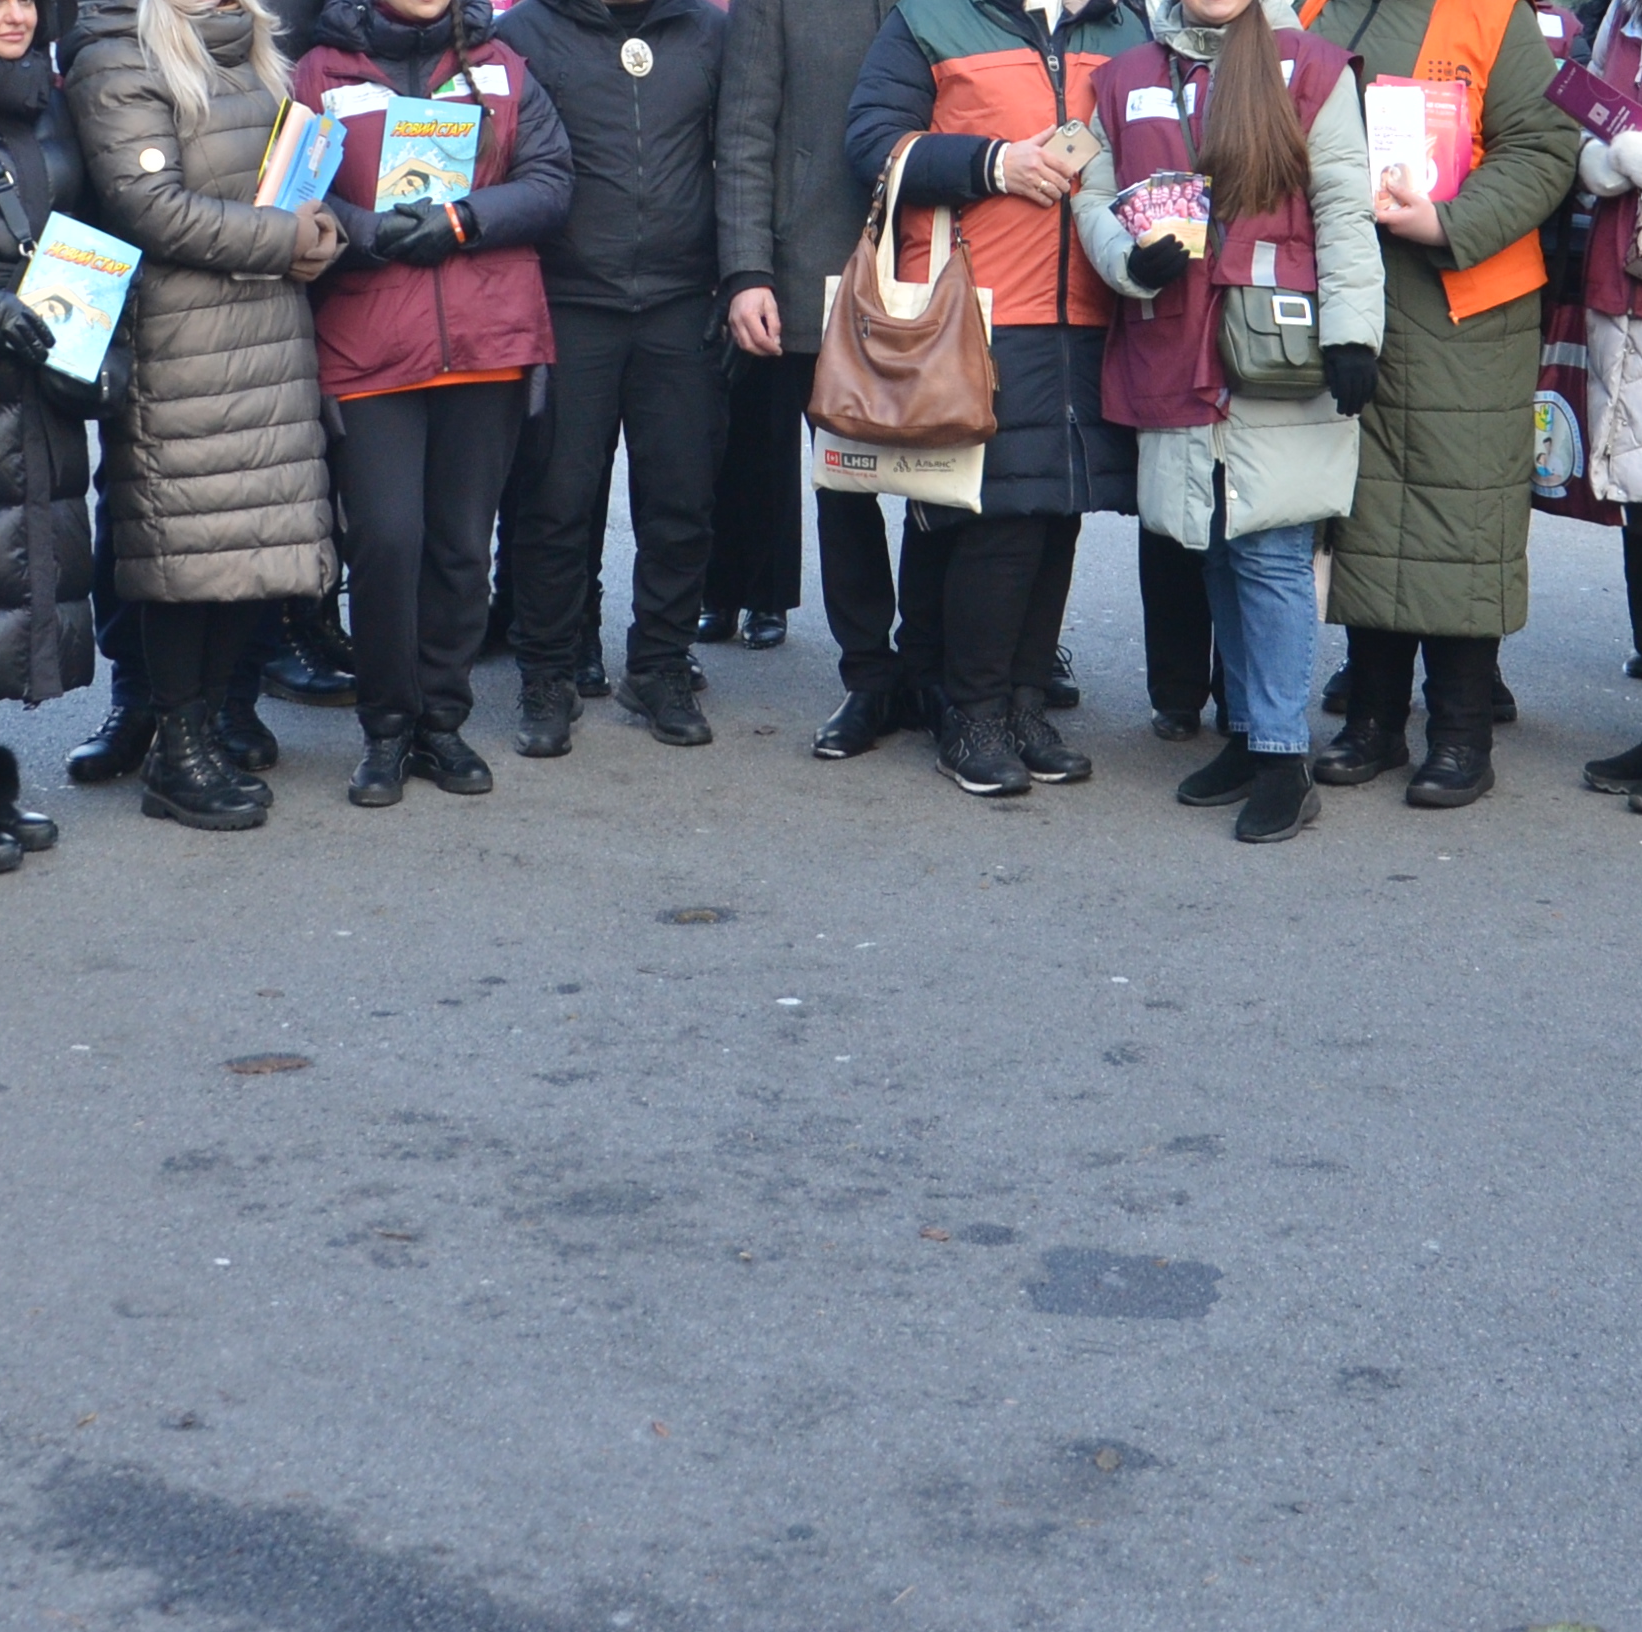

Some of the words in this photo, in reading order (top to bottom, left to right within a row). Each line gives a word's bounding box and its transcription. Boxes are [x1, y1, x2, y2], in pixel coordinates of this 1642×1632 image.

[390, 119, 438, 137] НОВИЙ
[437, 122, 476, 137] СТАРТ
[43, 240, 95, 267] НОВИЙ
[91, 254, 132, 277] СТАРТ
[843, 455, 875, 469] LHSI
